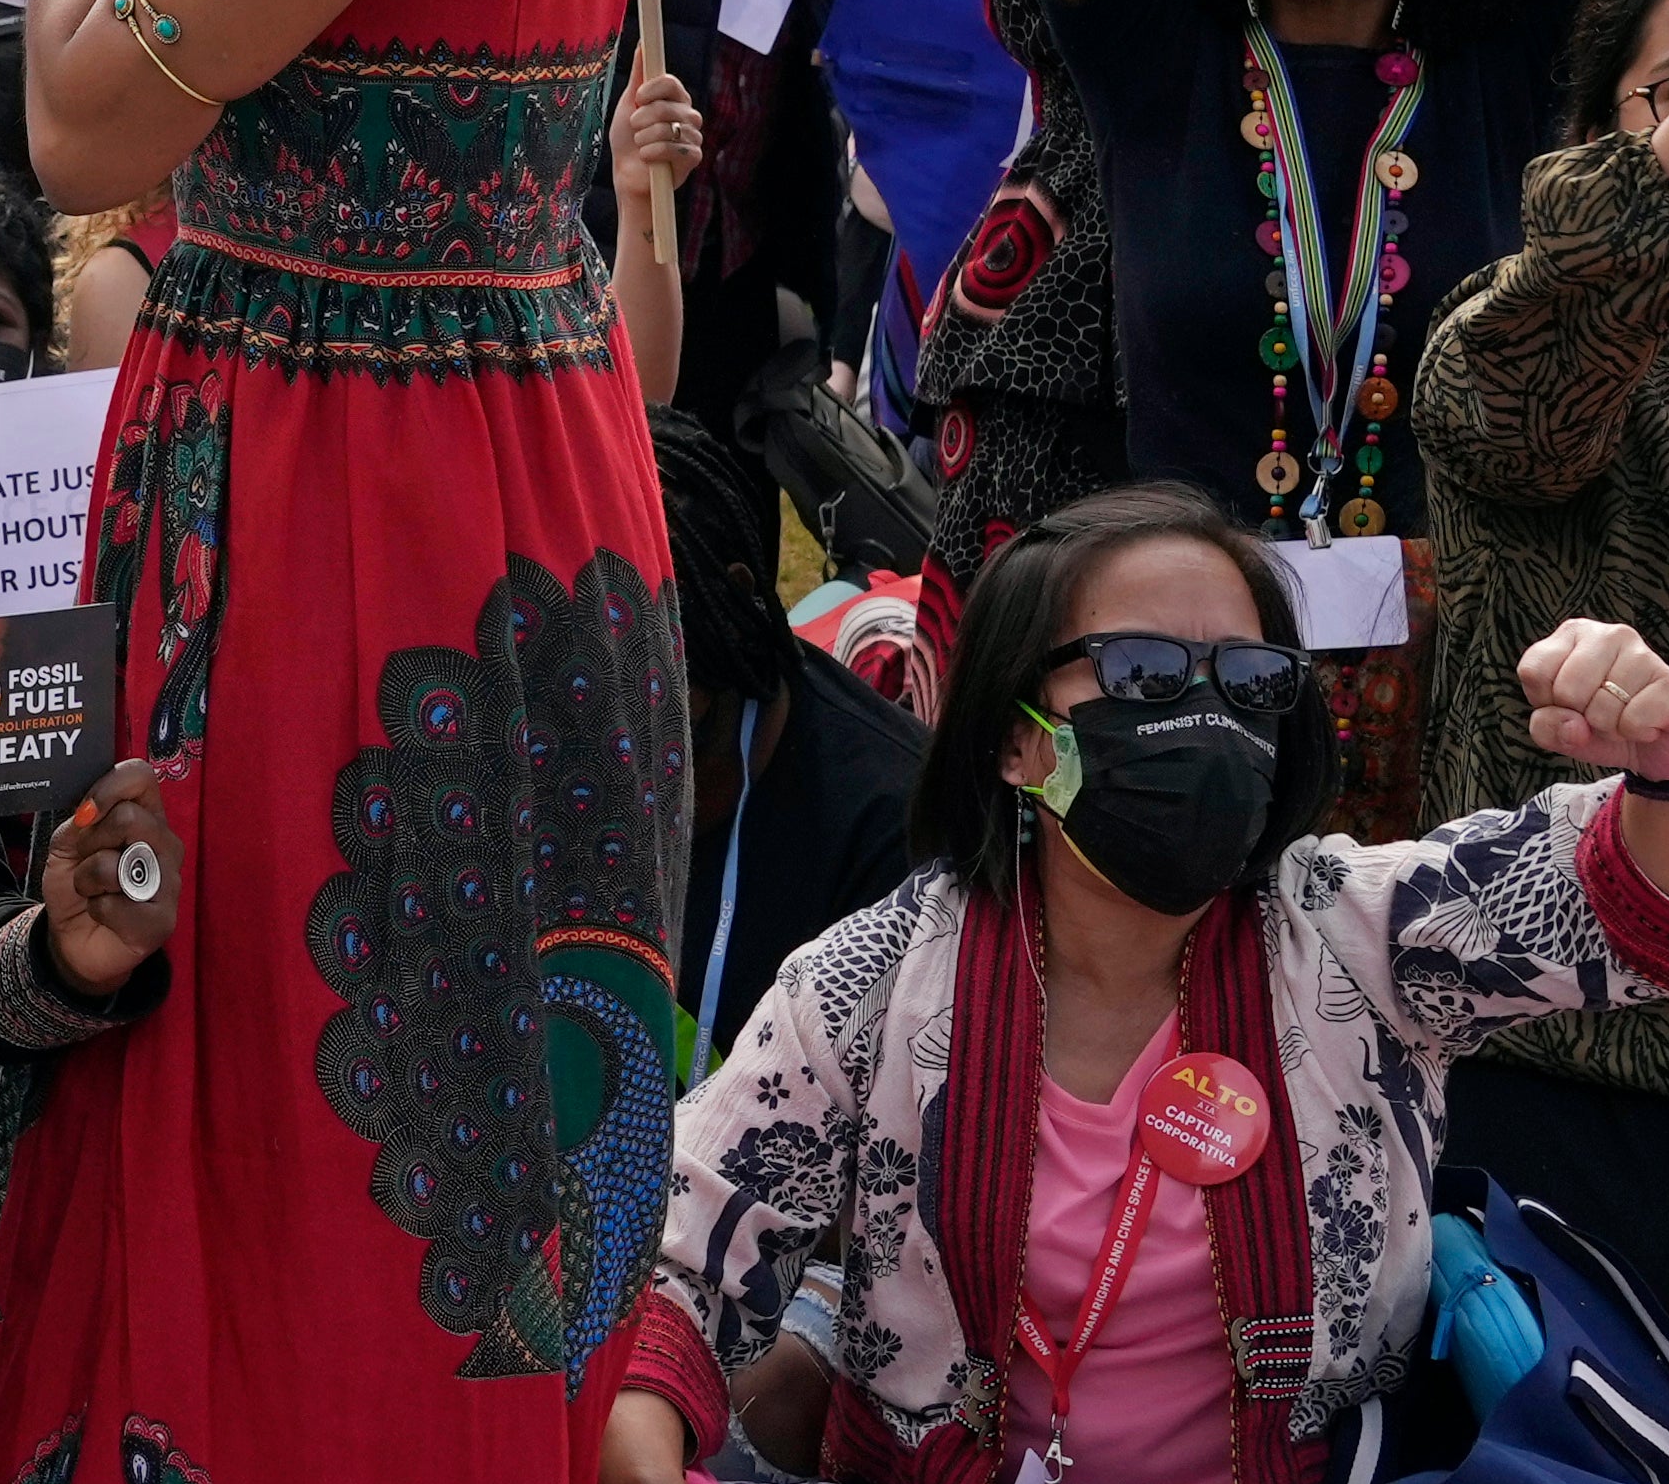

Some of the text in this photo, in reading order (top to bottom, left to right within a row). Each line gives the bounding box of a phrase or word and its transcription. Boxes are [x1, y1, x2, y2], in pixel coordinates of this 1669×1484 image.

[7, 662, 84, 689] FOSSIL
[7, 686, 84, 717] FUEL
[1136, 713, 1203, 736] FEMINIST
[1172, 1067, 1258, 1116] ALTO
[1145, 1114, 1237, 1168] CORPORATIVA
[1165, 1105, 1233, 1148] CAPTURA
[1073, 1312, 1101, 1354] HUMAN
[1092, 1267, 1117, 1313] RIGHTS
[1108, 1239, 1126, 1268] AND
[1117, 1206, 1137, 1239] CIVIC
[1128, 1167, 1151, 1207] SPACE
[1019, 1314, 1051, 1357] ACTION
